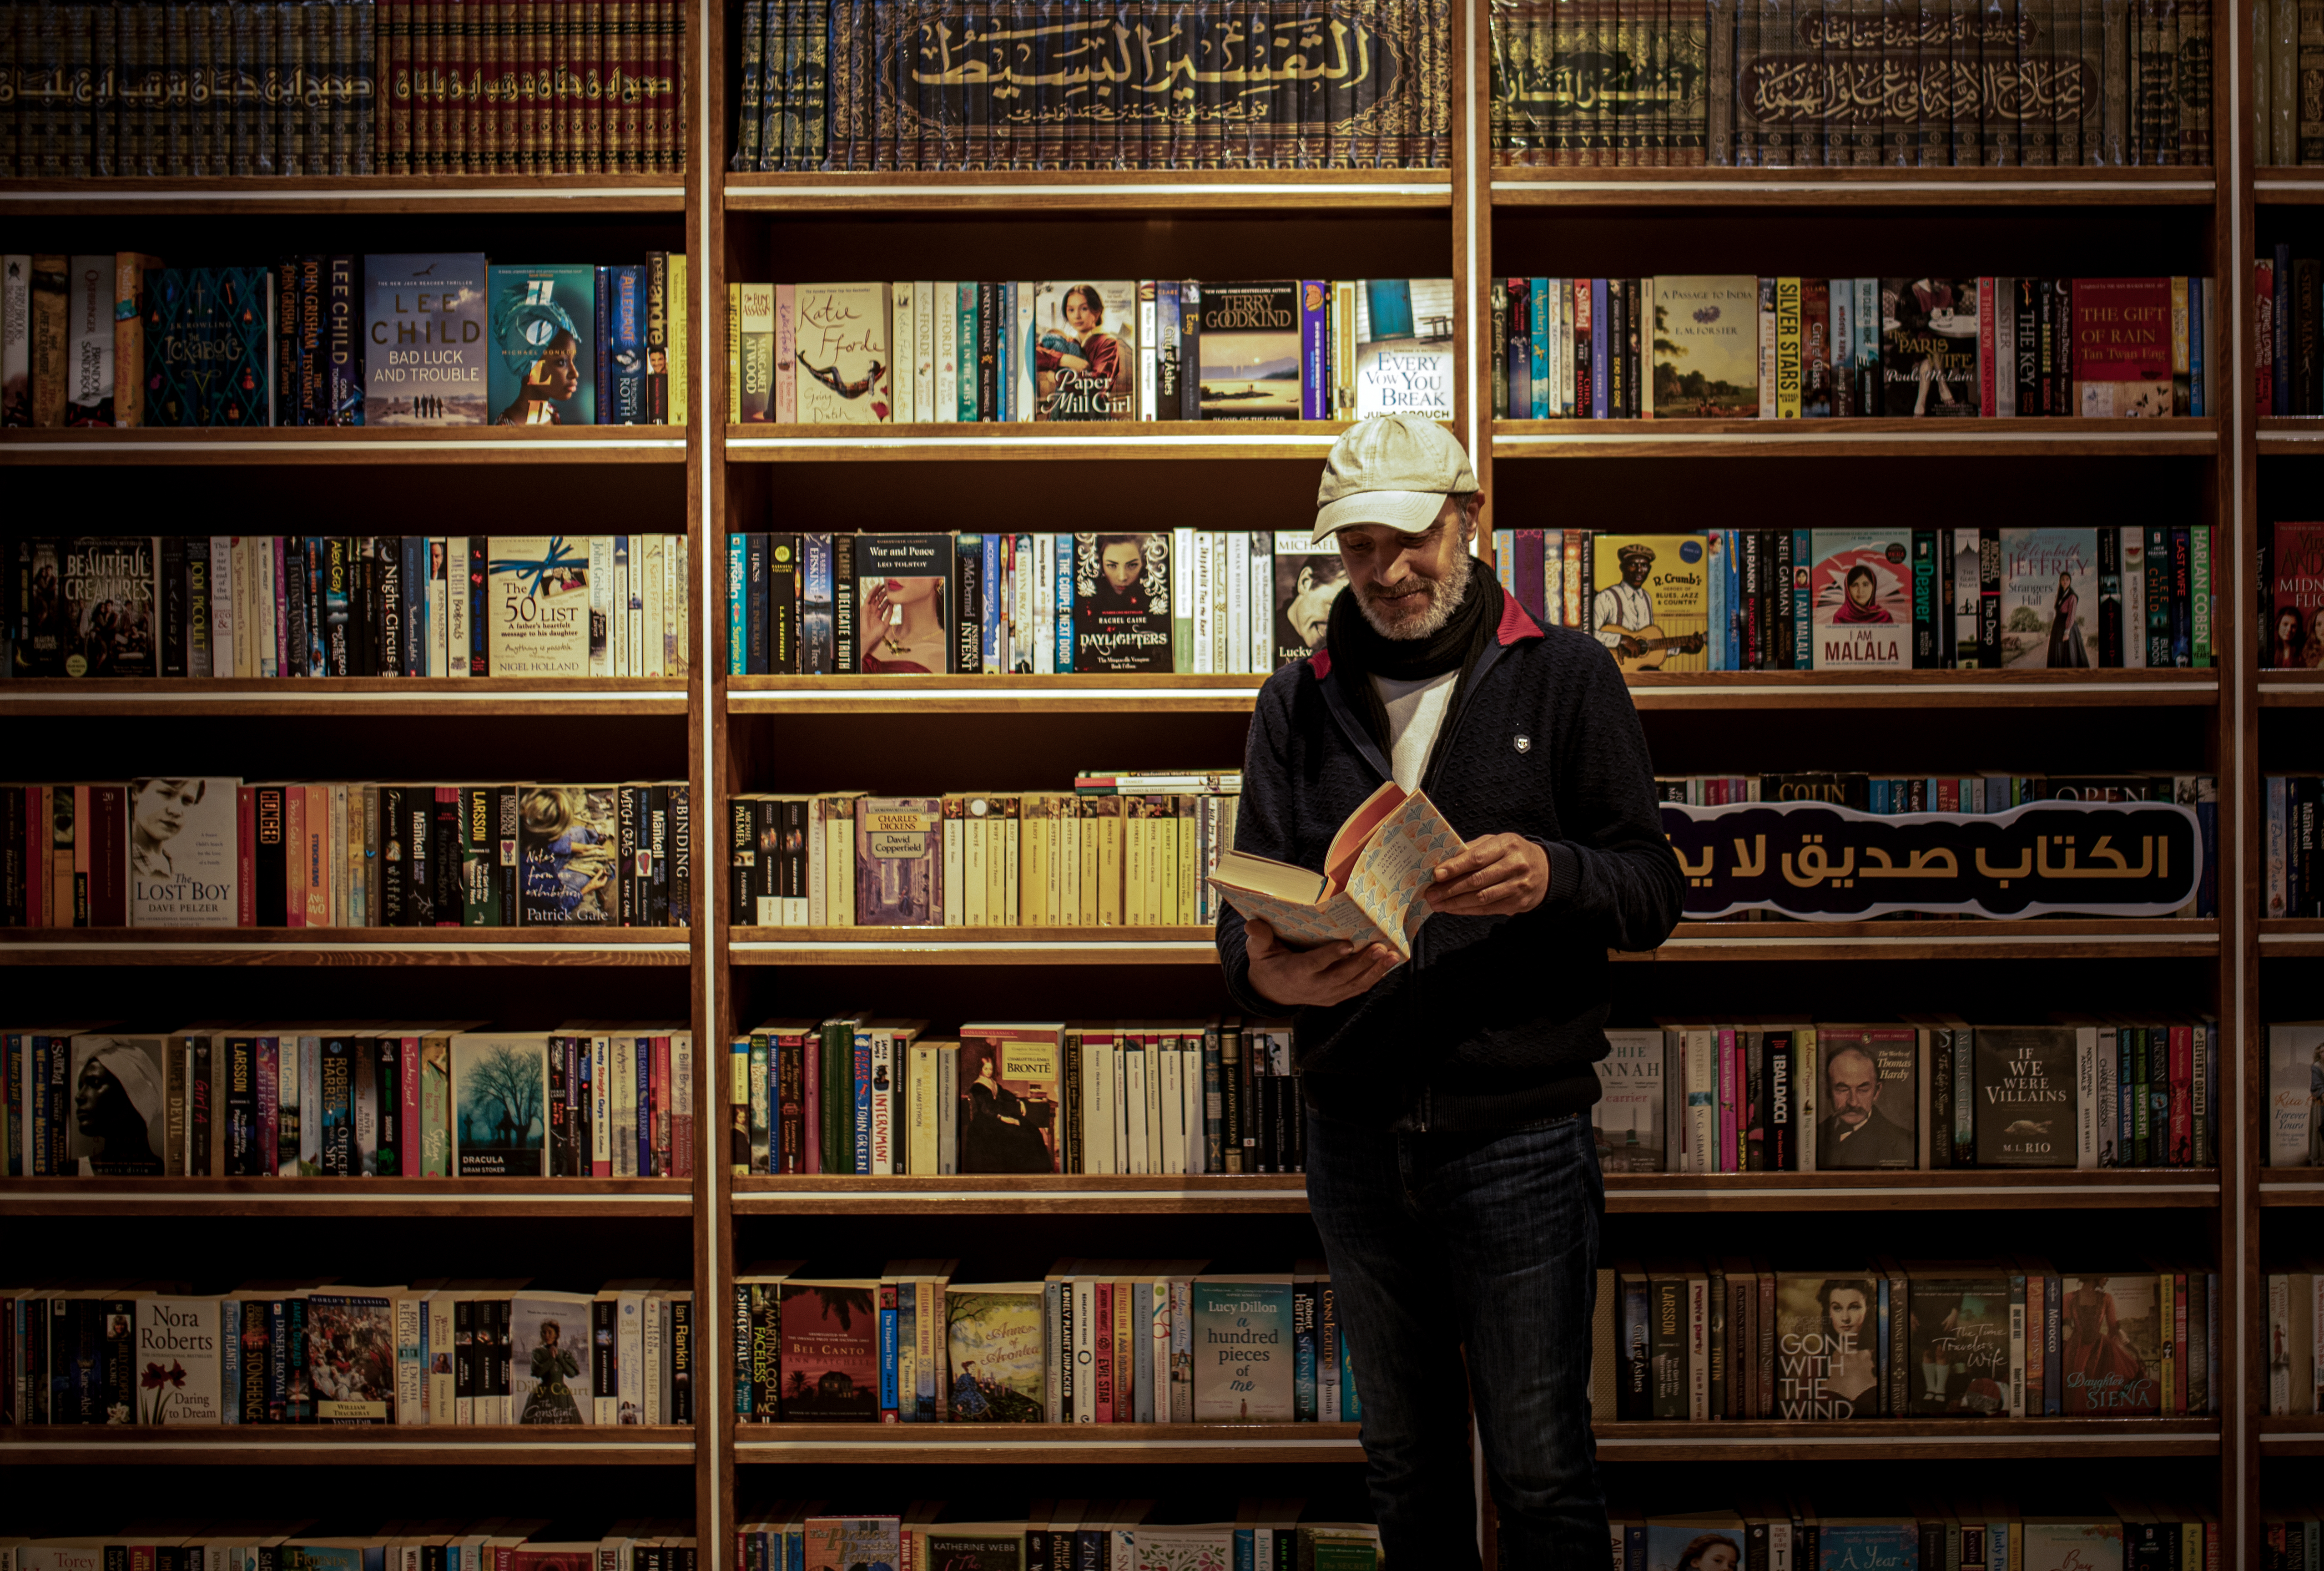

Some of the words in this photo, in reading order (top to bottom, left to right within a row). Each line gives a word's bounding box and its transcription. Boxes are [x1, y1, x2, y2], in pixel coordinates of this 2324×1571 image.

[332, 260, 348, 297] LEE
[396, 294, 455, 313] LEE
[800, 296, 862, 328] Katie
[1222, 295, 1274, 311] TERRY
[1780, 283, 1797, 335] SILVER
[1206, 310, 1291, 328] GOODKIND
[2081, 307, 2119, 323] THE
[2123, 307, 2166, 323] GIFT
[332, 301, 349, 365] CHILD
[372, 321, 480, 344] CHILD
[2082, 329, 2104, 343] OF
[2111, 329, 2156, 343] RAIN
[819, 325, 885, 365] Fforde
[1899, 338, 1948, 353] PARIS
[2082, 349, 2100, 360] Tan
[2106, 349, 2138, 360] Twan
[2142, 349, 2165, 361] Eng
[389, 351, 421, 364] BAD
[425, 350, 463, 364] LUCK
[746, 337, 756, 394] ATWOOD
[1378, 352, 1440, 372] EVERY
[1780, 338, 1798, 390] STARS
[1927, 353, 1974, 369] WIFE
[374, 369, 406, 382] AND
[410, 367, 479, 382] TROUBLE
[1056, 369, 1112, 390] Paper
[1366, 371, 1398, 384] VOW
[1402, 372, 1442, 391] YOU
[1886, 368, 1928, 383] Paula
[1930, 368, 1974, 382] McLain
[620, 378, 630, 417] ROTH
[1042, 391, 1089, 413] Mill
[1092, 391, 1131, 414] Girl
[1382, 389, 1446, 406] BREAK
[869, 546, 887, 556] War
[890, 546, 905, 556] and
[908, 546, 934, 556] Peace
[1780, 535, 1788, 560] NEIL
[67, 548, 150, 577] BEAUTIFUL
[1982, 539, 1990, 584] CONNELLY
[1991, 541, 1999, 580] MICHAEL
[2009, 553, 2089, 576] JEFFREY
[2193, 530, 2206, 589] HARLAN
[192, 561, 204, 590] JODI
[809, 547, 819, 601] ERSKINE
[65, 577, 155, 602] CREATURES
[385, 565, 398, 611] Night
[503, 583, 528, 594] The
[1780, 565, 1789, 616] GAIMAN
[2149, 567, 2158, 612] CHILD
[2160, 575, 2169, 604] LEE
[504, 597, 537, 622] 50
[541, 607, 578, 621] LIST
[1986, 598, 1996, 617] The
[2022, 595, 2041, 606] Hall
[192, 595, 205, 651] PICOULT
[2193, 591, 2207, 644] COBEN
[385, 612, 398, 665] Circus
[1850, 630, 1853, 642] I
[1855, 630, 1871, 641] AM
[1985, 619, 1996, 646] Drop
[1825, 642, 1899, 660] MALALA
[500, 662, 526, 671] NIGEL
[530, 662, 579, 671] HOLLAND
[260, 789, 280, 844] HUNGER
[473, 791, 486, 842] LARSSON
[878, 814, 918, 823] CHARLES
[880, 822, 916, 830] DICKENS
[413, 811, 426, 860] Mankell
[735, 806, 745, 849] PALMER
[676, 804, 689, 878] BINDING
[875, 843, 921, 853] Copperfield
[887, 835, 910, 844] David
[1732, 833, 1766, 878] لا
[1781, 833, 1958, 888] صديق
[1975, 835, 2168, 889] الكتاب
[175, 874, 192, 884] The
[137, 881, 189, 901] LOST
[192, 881, 231, 901] BOY
[149, 904, 176, 912] DAVE
[180, 904, 219, 912] PELZER
[527, 907, 572, 921] Patrick
[576, 908, 609, 921] Gale
[1877, 1057, 1911, 1068] Thomas
[2018, 1048, 2033, 1060] IF
[234, 1043, 247, 1093] LARSSON
[1880, 1069, 1909, 1081] Hardy
[2009, 1061, 2043, 1076] WE
[325, 1057, 336, 1111] HARRIS
[337, 1057, 348, 1111] ROBERT
[1774, 1058, 1787, 1124] BALDACCI
[2003, 1077, 2049, 1089] WERE
[1605, 1093, 1648, 1102] carrier
[1985, 1086, 2067, 1104] VILLAINS
[857, 1106, 868, 1128] JOHN
[876, 1093, 888, 1164] INTERNMENT
[857, 1131, 868, 1171] GREEN
[153, 1305, 199, 1326] Nora
[676, 1304, 687, 1323] Ian
[1208, 1300, 1237, 1314] Lucy
[1240, 1300, 1277, 1314] Dillon
[1662, 1287, 1676, 1336] LARSSON
[141, 1328, 212, 1350] Roberts
[1208, 1329, 1278, 1344] hundred
[1780, 1334, 1858, 1355] GONE
[676, 1325, 688, 1370] Rankin
[754, 1326, 766, 1383] FACELESS
[793, 1343, 816, 1354] BEL
[822, 1344, 865, 1355] CANTO
[1219, 1348, 1270, 1365] pieces
[1236, 1365, 1250, 1376] of
[1780, 1356, 1845, 1377] WITH
[1780, 1378, 1828, 1398] THE
[175, 1393, 209, 1407] Daring
[1780, 1400, 1854, 1419] WIND
[169, 1408, 179, 1418] to
[182, 1407, 216, 1418] Dream
[934, 1543, 985, 1551] KATHERINE
[988, 1544, 1016, 1552] WEBB
[1863, 1547, 1902, 1568] Year
[54, 1551, 95, 1569] Torey
